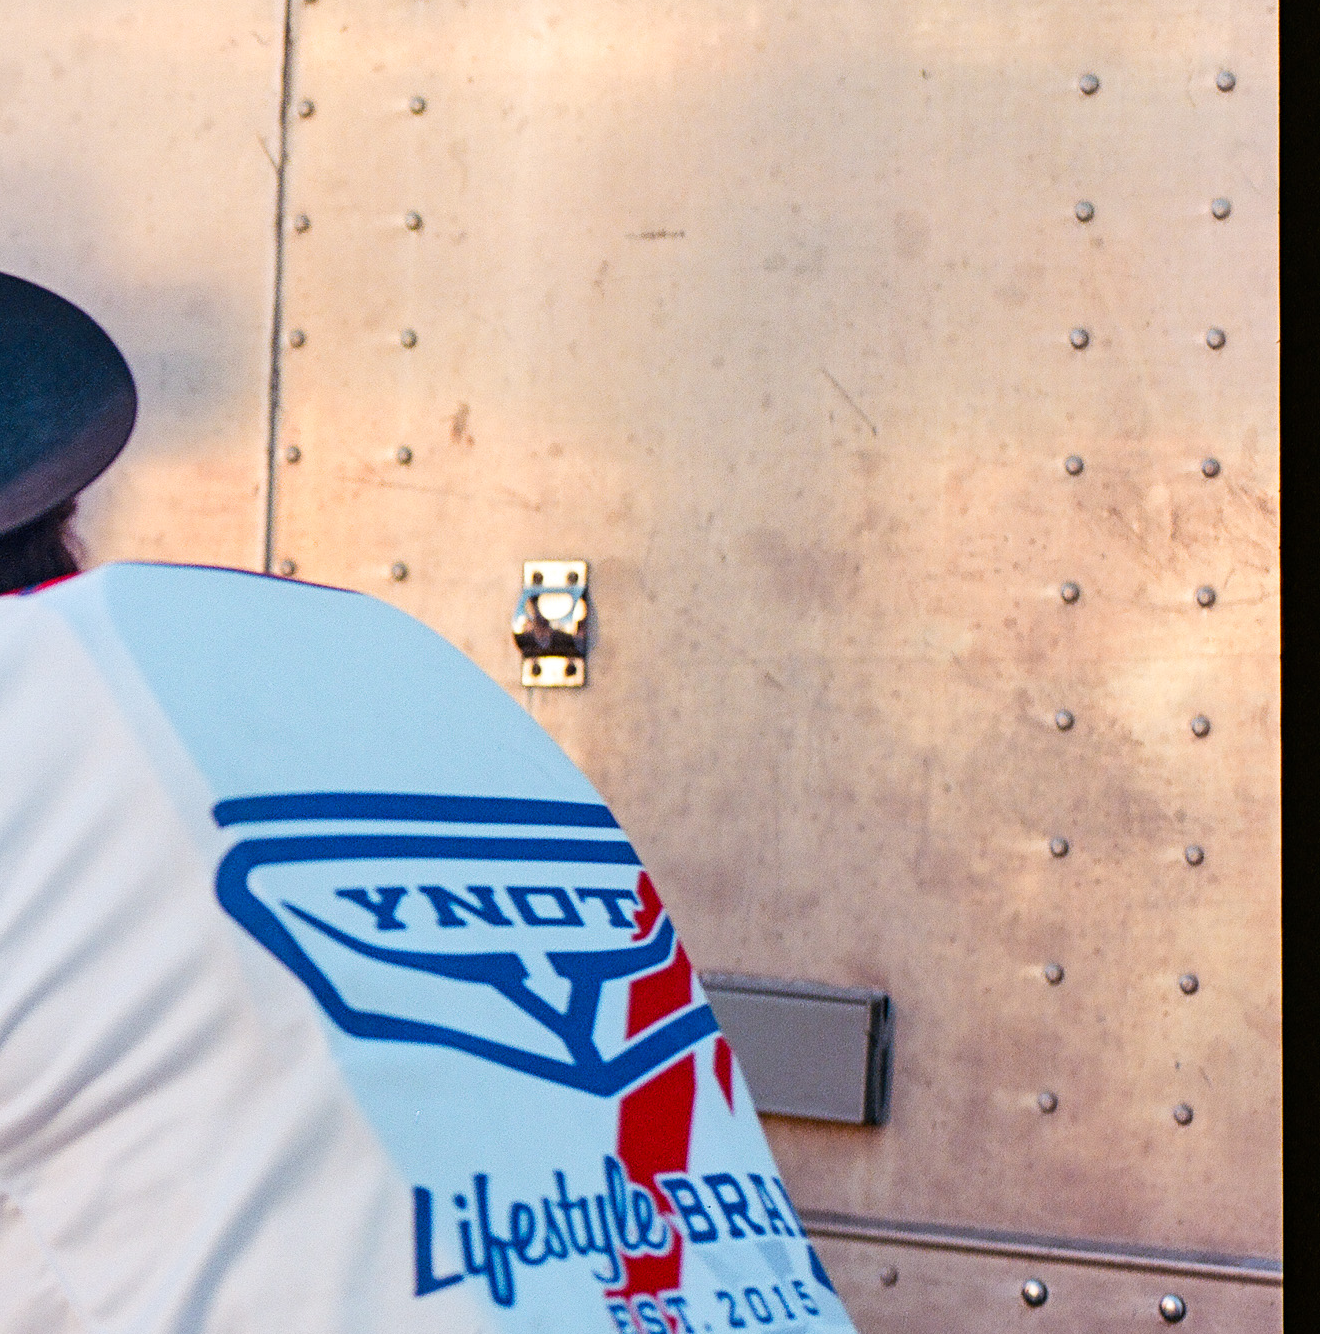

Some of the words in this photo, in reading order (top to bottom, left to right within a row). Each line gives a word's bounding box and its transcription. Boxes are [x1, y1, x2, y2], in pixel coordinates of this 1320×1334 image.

[334, 884, 640, 931] YNOT
[413, 1154, 668, 1308] Lifestyle
[714, 1278, 821, 1329] 2015
